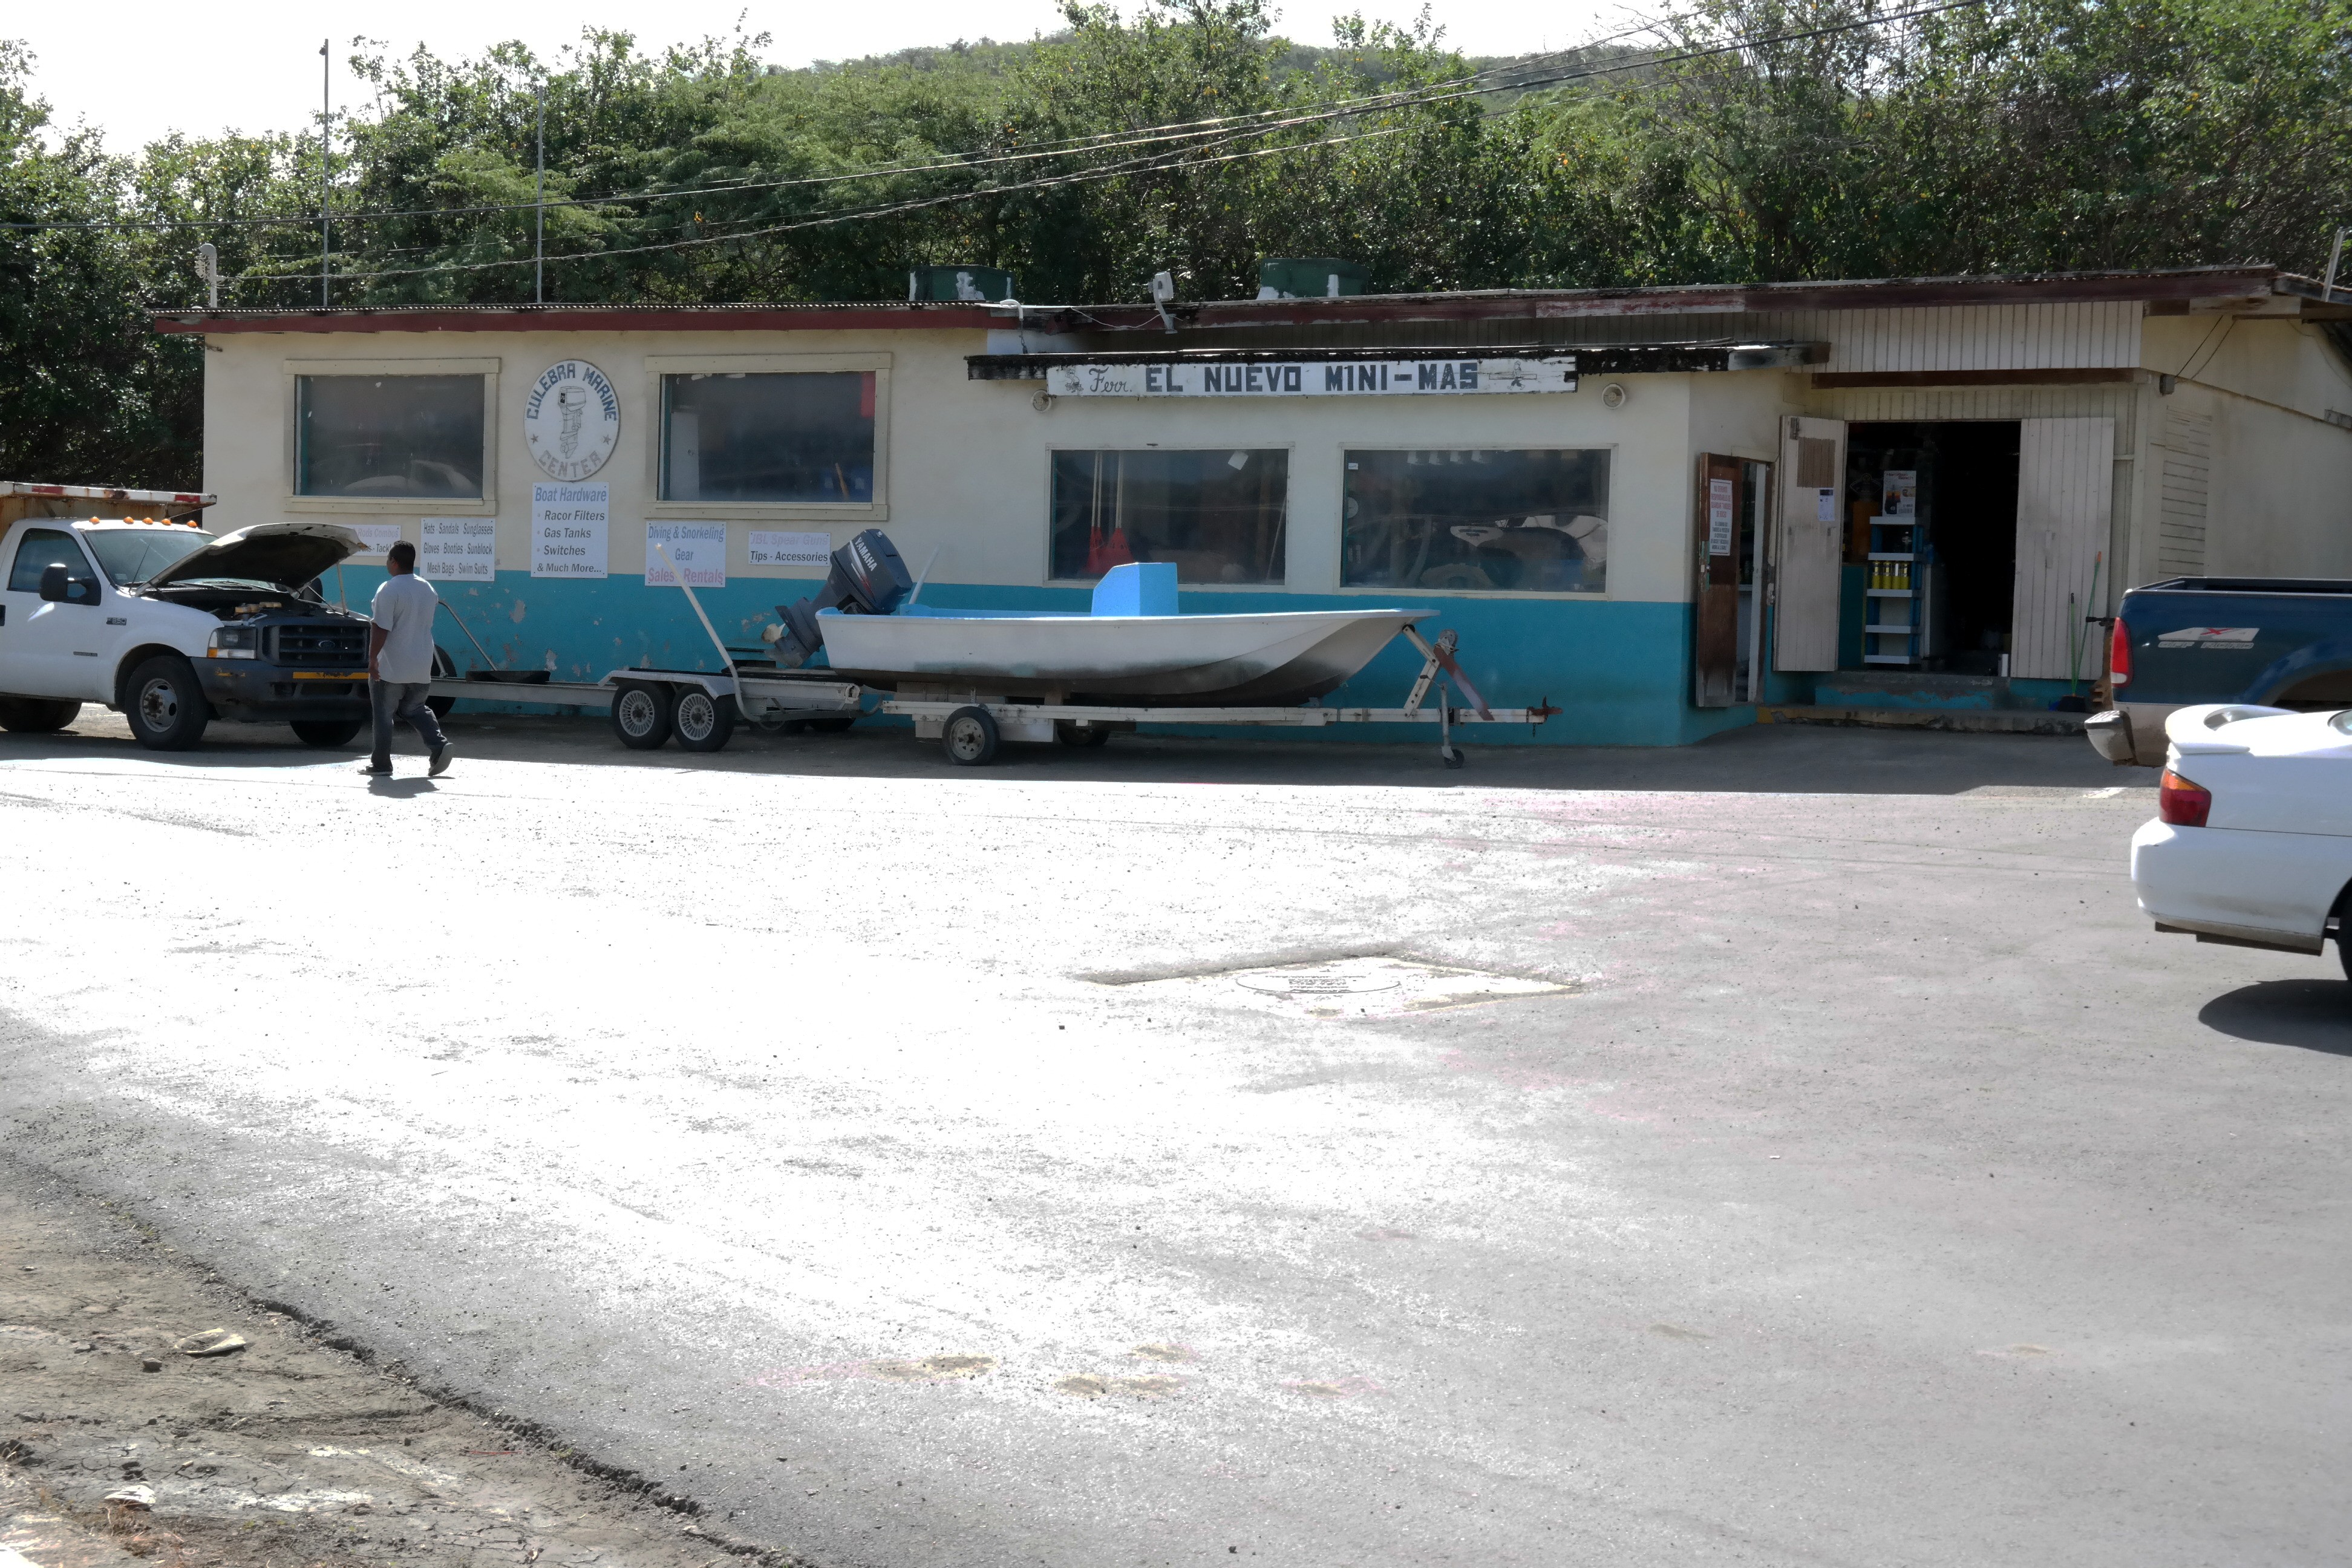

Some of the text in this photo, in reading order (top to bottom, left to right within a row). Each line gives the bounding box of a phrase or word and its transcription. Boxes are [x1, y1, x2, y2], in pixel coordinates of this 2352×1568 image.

[1145, 367, 1183, 392] EL
[1204, 365, 1301, 392] NUEVO
[526, 363, 617, 421] CULEBRA MARINE
[538, 449, 602, 478] CENTER
[535, 487, 607, 502] Boat Hardware
[544, 510, 605, 521] Racor Filters
[358, 528, 399, 538] Rods Combos
[423, 523, 493, 537] Hats Sandals Sunglasses
[544, 527, 592, 538] Gas Tanks
[648, 526, 725, 543] Diving & Snorkeling
[771, 534, 800, 547] Spear
[803, 534, 829, 546] Guns
[376, 543, 391, 552] Tackl
[423, 542, 492, 555] Gloves Booties Sunblock
[544, 545, 586, 556] Switches
[675, 548, 694, 561] Gear
[751, 550, 828, 563] Tips Accessories
[855, 537, 877, 572] YAMAHA
[426, 562, 488, 576] Mesh Bags Swim Suits
[537, 563, 601, 573] & Much More...
[648, 567, 724, 583] Sales Rentals
